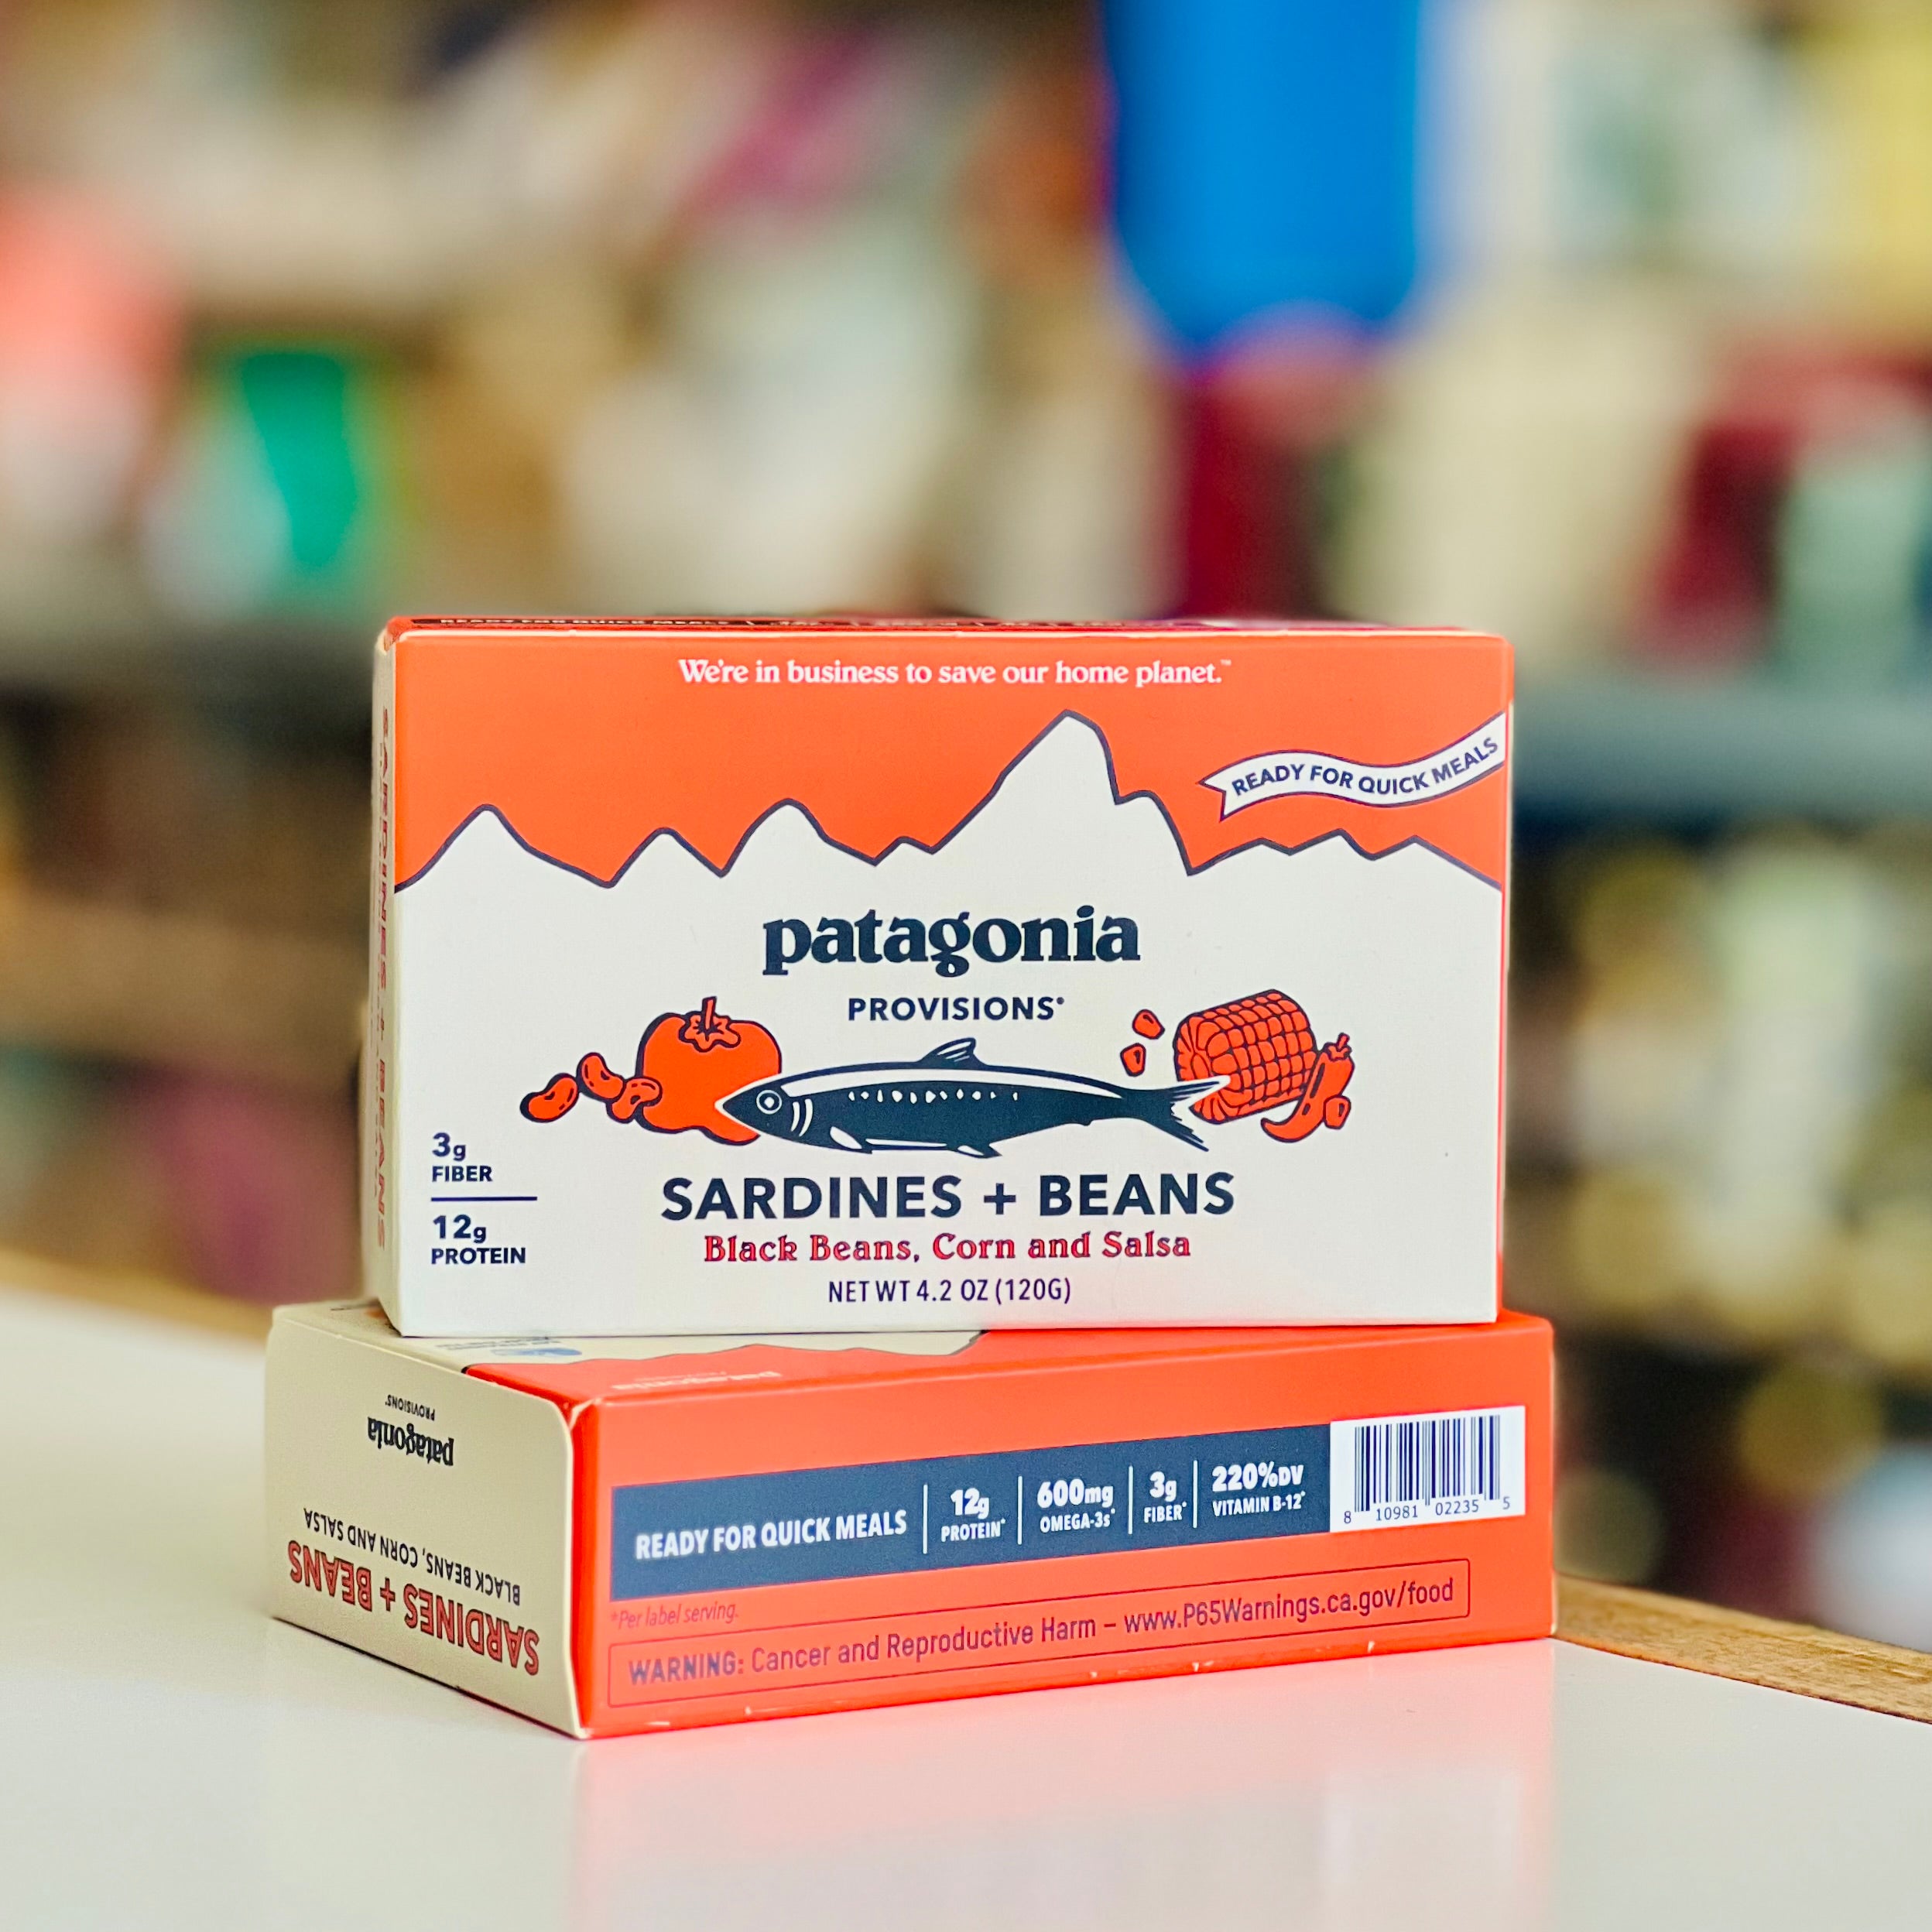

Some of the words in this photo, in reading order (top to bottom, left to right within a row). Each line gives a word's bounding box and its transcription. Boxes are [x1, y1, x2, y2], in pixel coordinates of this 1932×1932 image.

[678, 659, 748, 683] We're
[755, 659, 780, 683] in
[787, 659, 899, 683] business
[906, 663, 932, 683] to
[938, 666, 996, 683] save
[1002, 666, 1049, 683] our
[1056, 660, 1129, 683] home
[1231, 763, 1305, 796] READY
[1310, 765, 1352, 790] FOR
[1358, 771, 1430, 796] QUICK
[1431, 736, 1499, 784] MEALS
[762, 905, 1141, 978] patagonia
[432, 1132, 466, 1162] 3g
[431, 1165, 493, 1182] FIBER
[661, 1174, 962, 1221] SARDINES
[983, 1183, 1017, 1215] +
[1040, 1172, 1235, 1216] BEANS
[432, 1214, 487, 1244] 12g
[431, 1247, 526, 1265] PROTEIN
[704, 1234, 798, 1262] Black
[810, 1234, 920, 1263] Beans,
[932, 1232, 1016, 1260] Corn
[1028, 1231, 1091, 1259] and
[1101, 1230, 1191, 1258] Salsa
[828, 1280, 870, 1303] NET
[875, 1279, 911, 1302] WT
[916, 1279, 952, 1301] 4.2
[961, 1278, 988, 1302] OZ
[995, 1277, 1071, 1305] (120G)
[368, 1416, 454, 1466] patagonia
[1036, 1478, 1114, 1509] 600mg
[1149, 1471, 1177, 1502] 3g
[949, 1487, 990, 1519] 12g
[1212, 1497, 1270, 1517] VITAMIN
[1344, 1510, 1352, 1524] 8
[1375, 1505, 1419, 1521] 10981
[1435, 1499, 1479, 1516] 02235
[1502, 1496, 1510, 1509] 5
[303, 1507, 344, 1541] SALSA
[348, 1525, 376, 1553] AND
[635, 1529, 708, 1560] READY
[712, 1525, 757, 1552] FOR
[760, 1517, 831, 1547] QUICK
[835, 1509, 907, 1540] MEALS
[380, 1536, 418, 1567] CORN
[422, 1547, 471, 1588] BEANS,
[288, 1540, 372, 1612] BEANS
[475, 1570, 520, 1606] BLACK
[379, 1577, 396, 1612] +
[404, 1583, 540, 1675] SARDINES
[646, 1603, 682, 1626] label
[683, 1601, 739, 1624] serving.
[628, 1651, 744, 1685] WARNING:
[752, 1646, 831, 1673] Cancer
[838, 1635, 879, 1663] and
[887, 1621, 1034, 1663] Reproductive
[1041, 1616, 1096, 1643] Harm
[1124, 1577, 1454, 1633] www.P65Warnings.ca.gov/food
